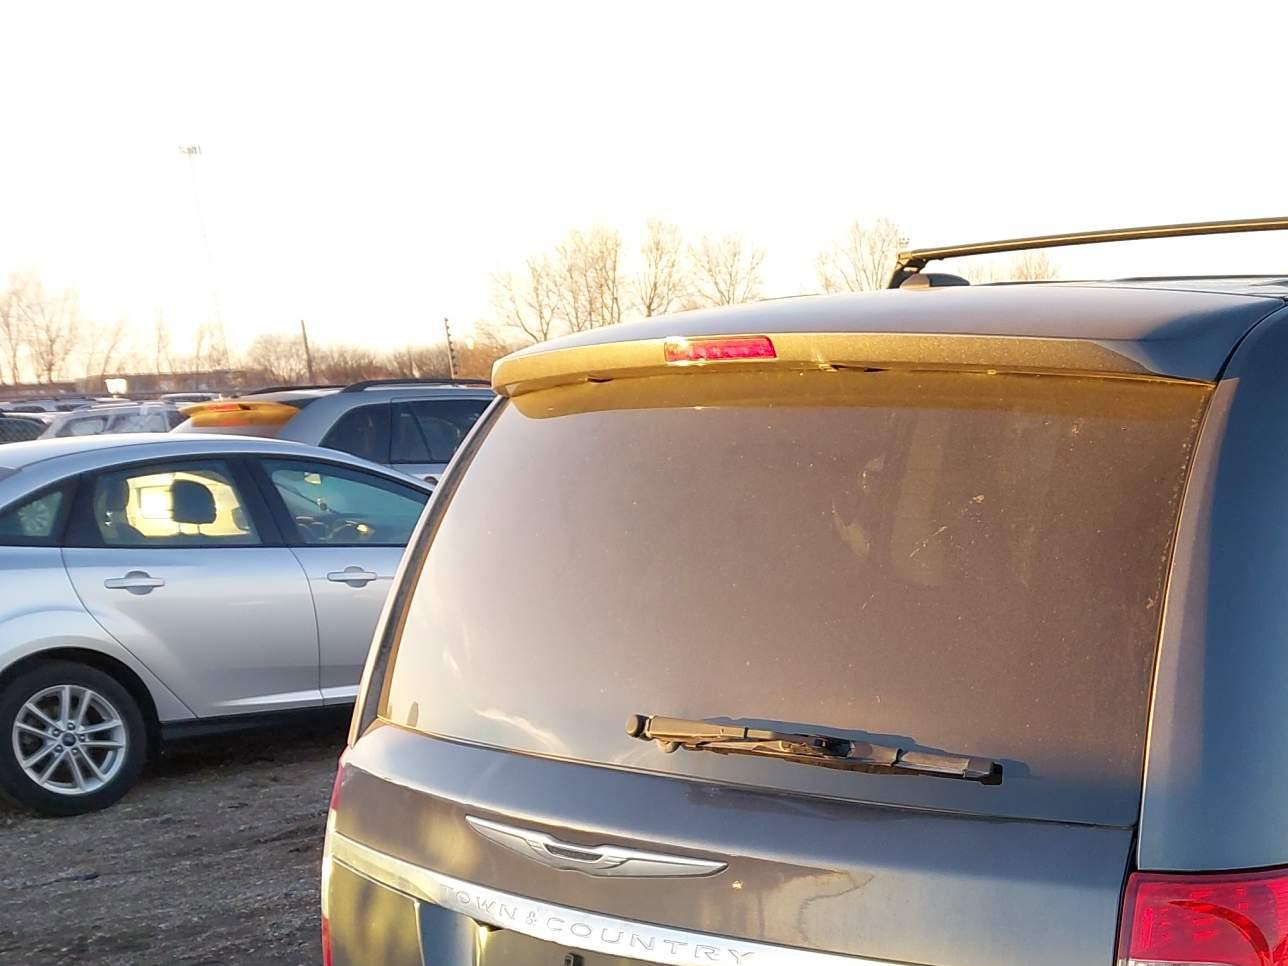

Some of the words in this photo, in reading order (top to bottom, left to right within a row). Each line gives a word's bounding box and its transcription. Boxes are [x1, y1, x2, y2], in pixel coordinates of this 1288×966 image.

[439, 883, 518, 920] TOWN
[526, 910, 538, 926] &
[546, 916, 756, 966] COUNTRY
